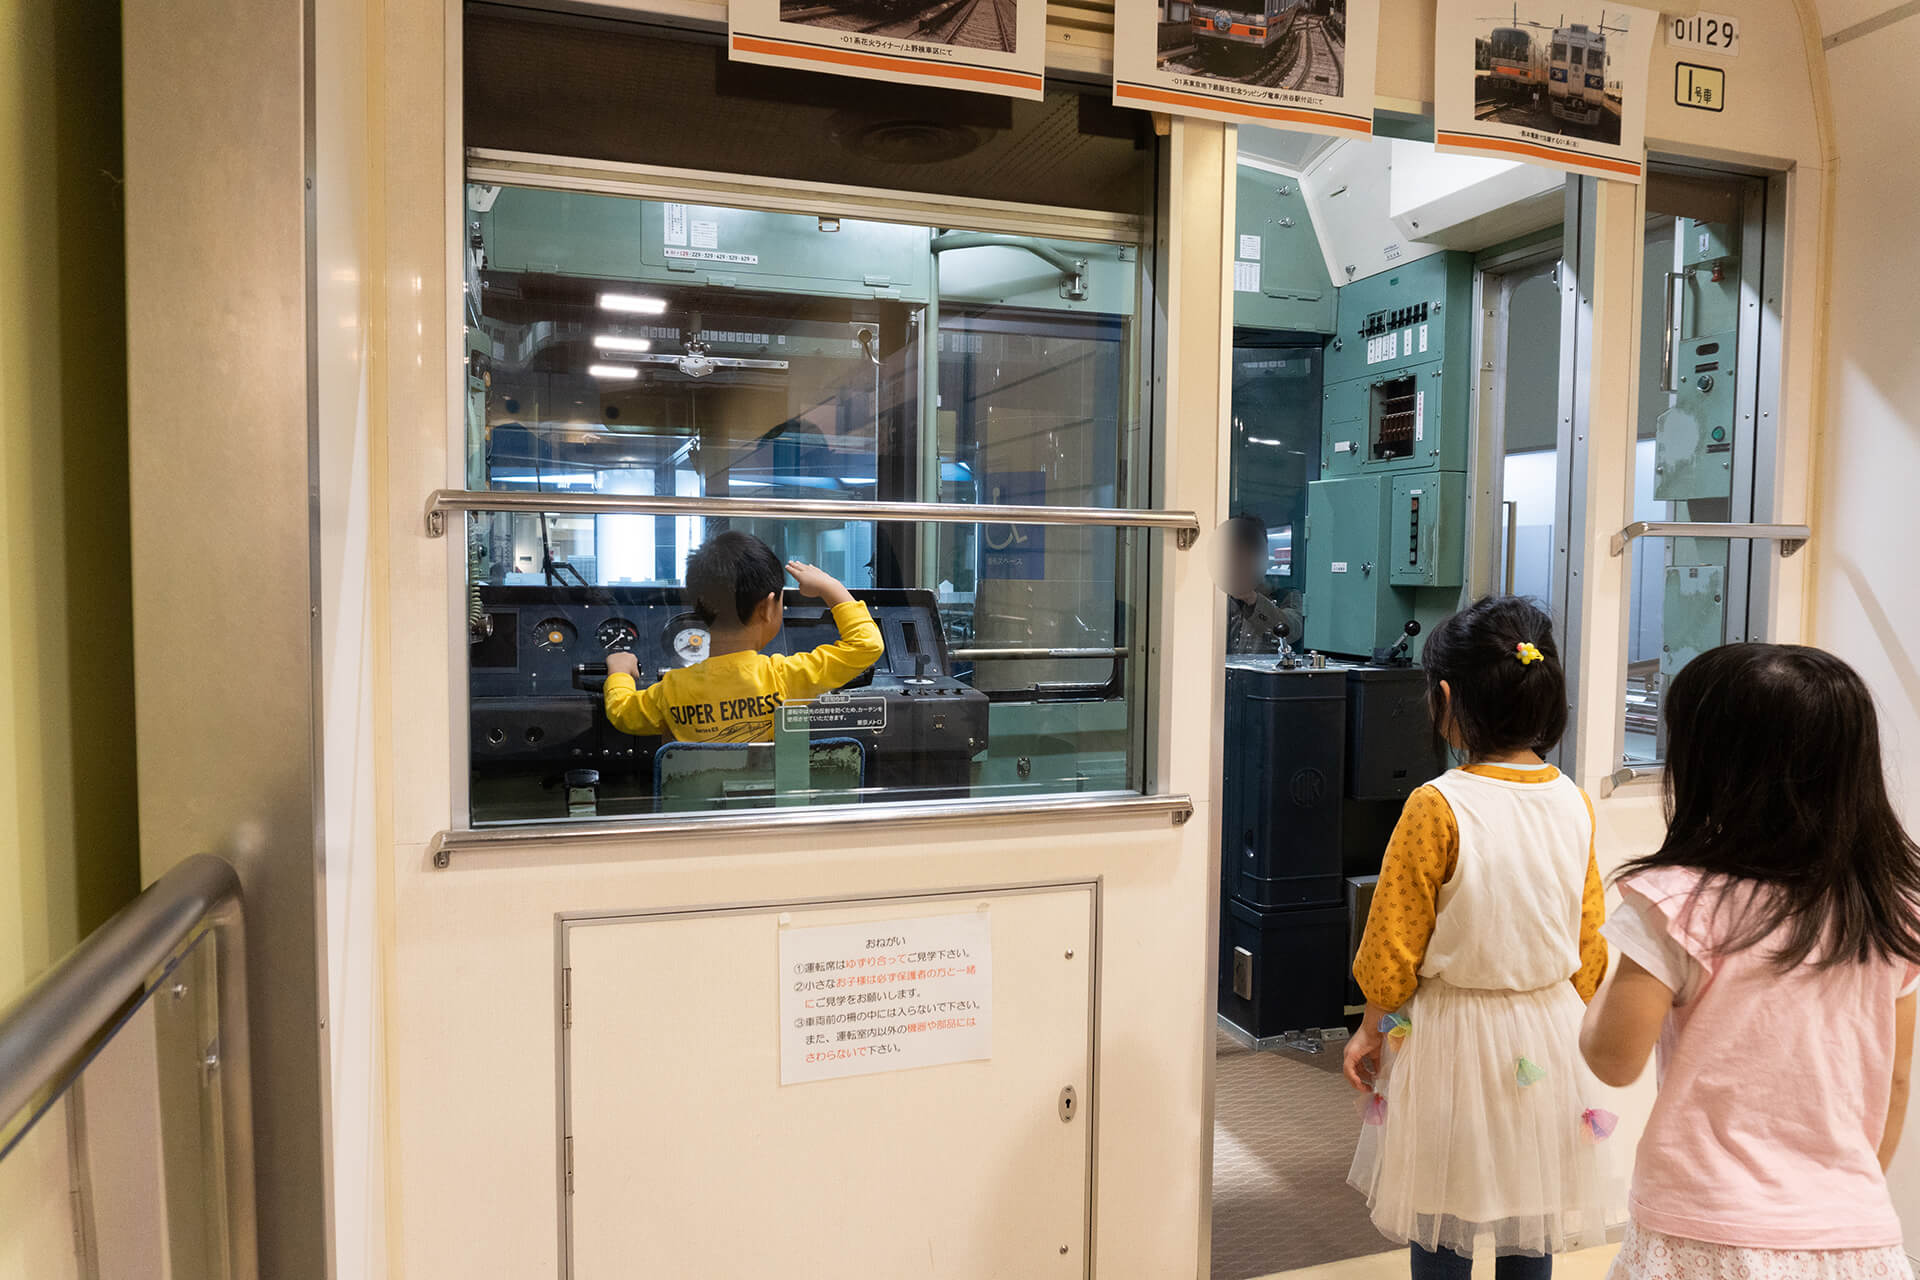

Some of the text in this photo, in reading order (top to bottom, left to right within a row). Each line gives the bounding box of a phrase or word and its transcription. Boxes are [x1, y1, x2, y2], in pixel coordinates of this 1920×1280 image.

[1675, 17, 1734, 48] 01129
[670, 692, 783, 725] SUPER EXPRESS
[865, 936, 906, 950] おねがい
[805, 988, 921, 1009] にご見学をお願いします。
[805, 1043, 901, 1063] さわらないで下さい。
